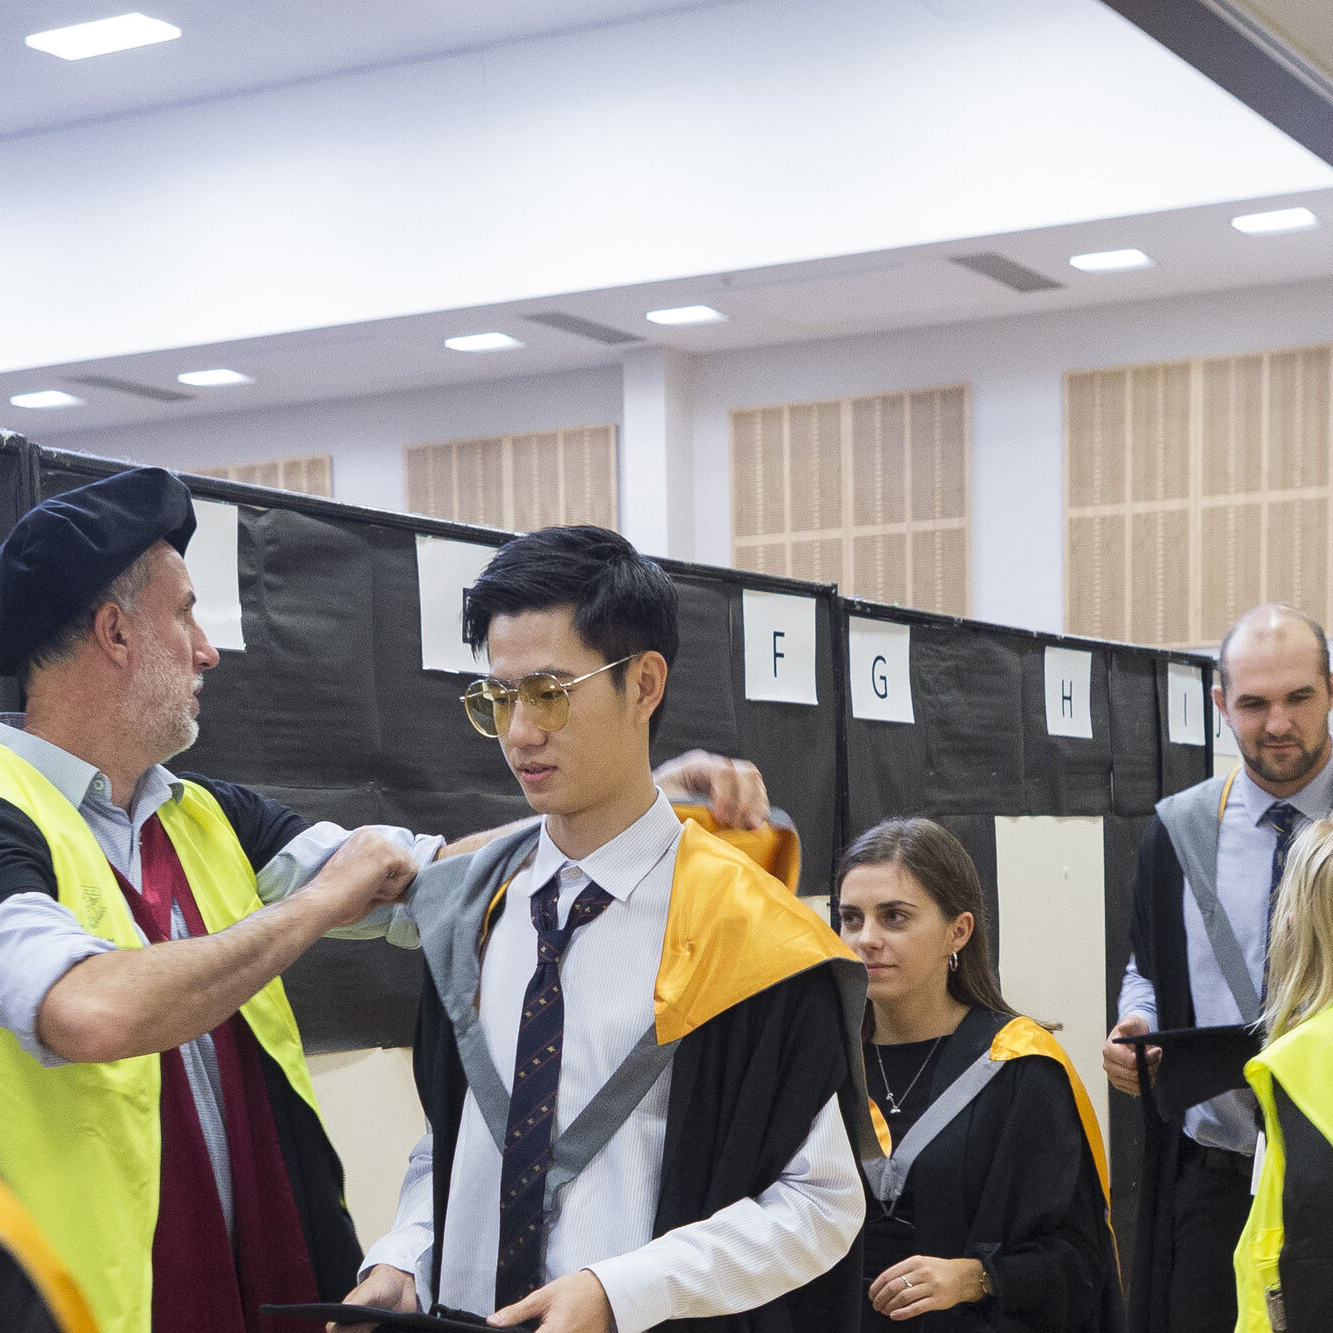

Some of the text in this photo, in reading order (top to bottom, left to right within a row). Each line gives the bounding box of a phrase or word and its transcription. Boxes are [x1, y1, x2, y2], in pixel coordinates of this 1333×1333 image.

[772, 631, 786, 678] F
[871, 655, 889, 700] G
[1060, 679, 1074, 718] H
